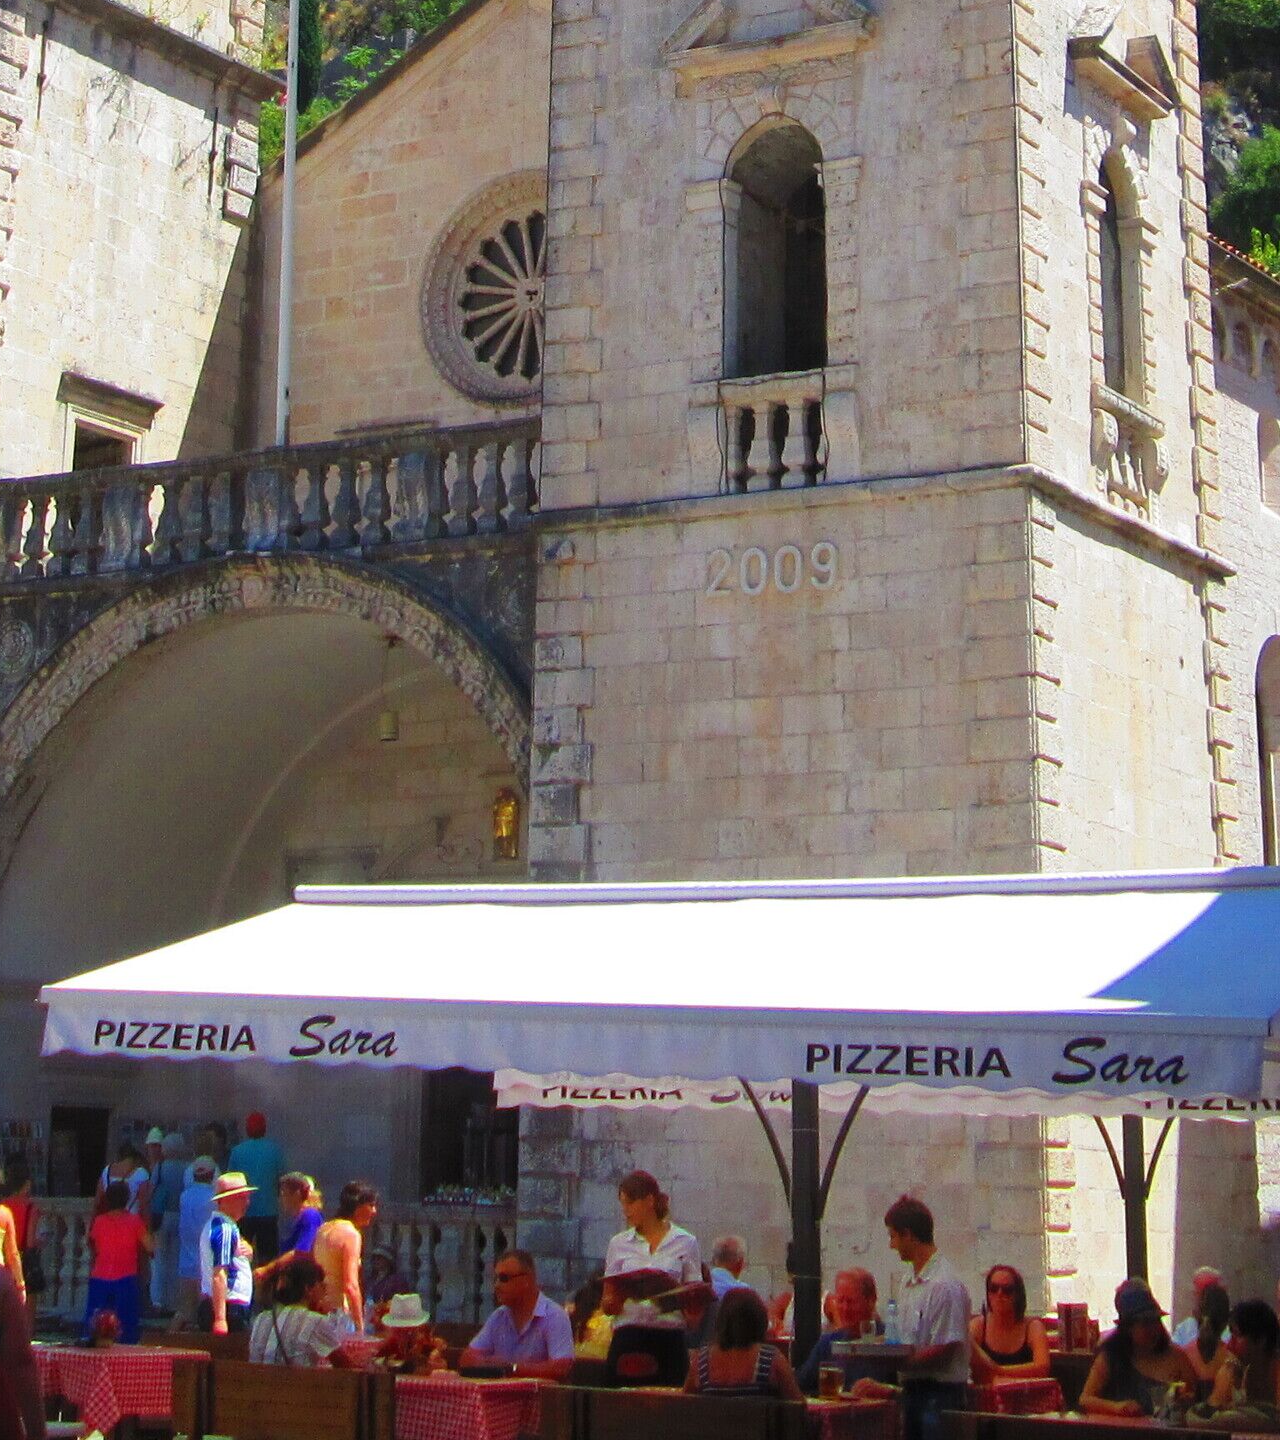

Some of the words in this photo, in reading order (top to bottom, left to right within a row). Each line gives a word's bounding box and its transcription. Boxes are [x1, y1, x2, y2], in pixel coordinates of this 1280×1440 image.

[705, 541, 837, 595] 2009
[94, 1019, 257, 1051] PIZZERIA
[289, 1014, 398, 1059] Sara
[805, 1043, 1012, 1079] PIZZERIA
[1052, 1036, 1190, 1085] Sara
